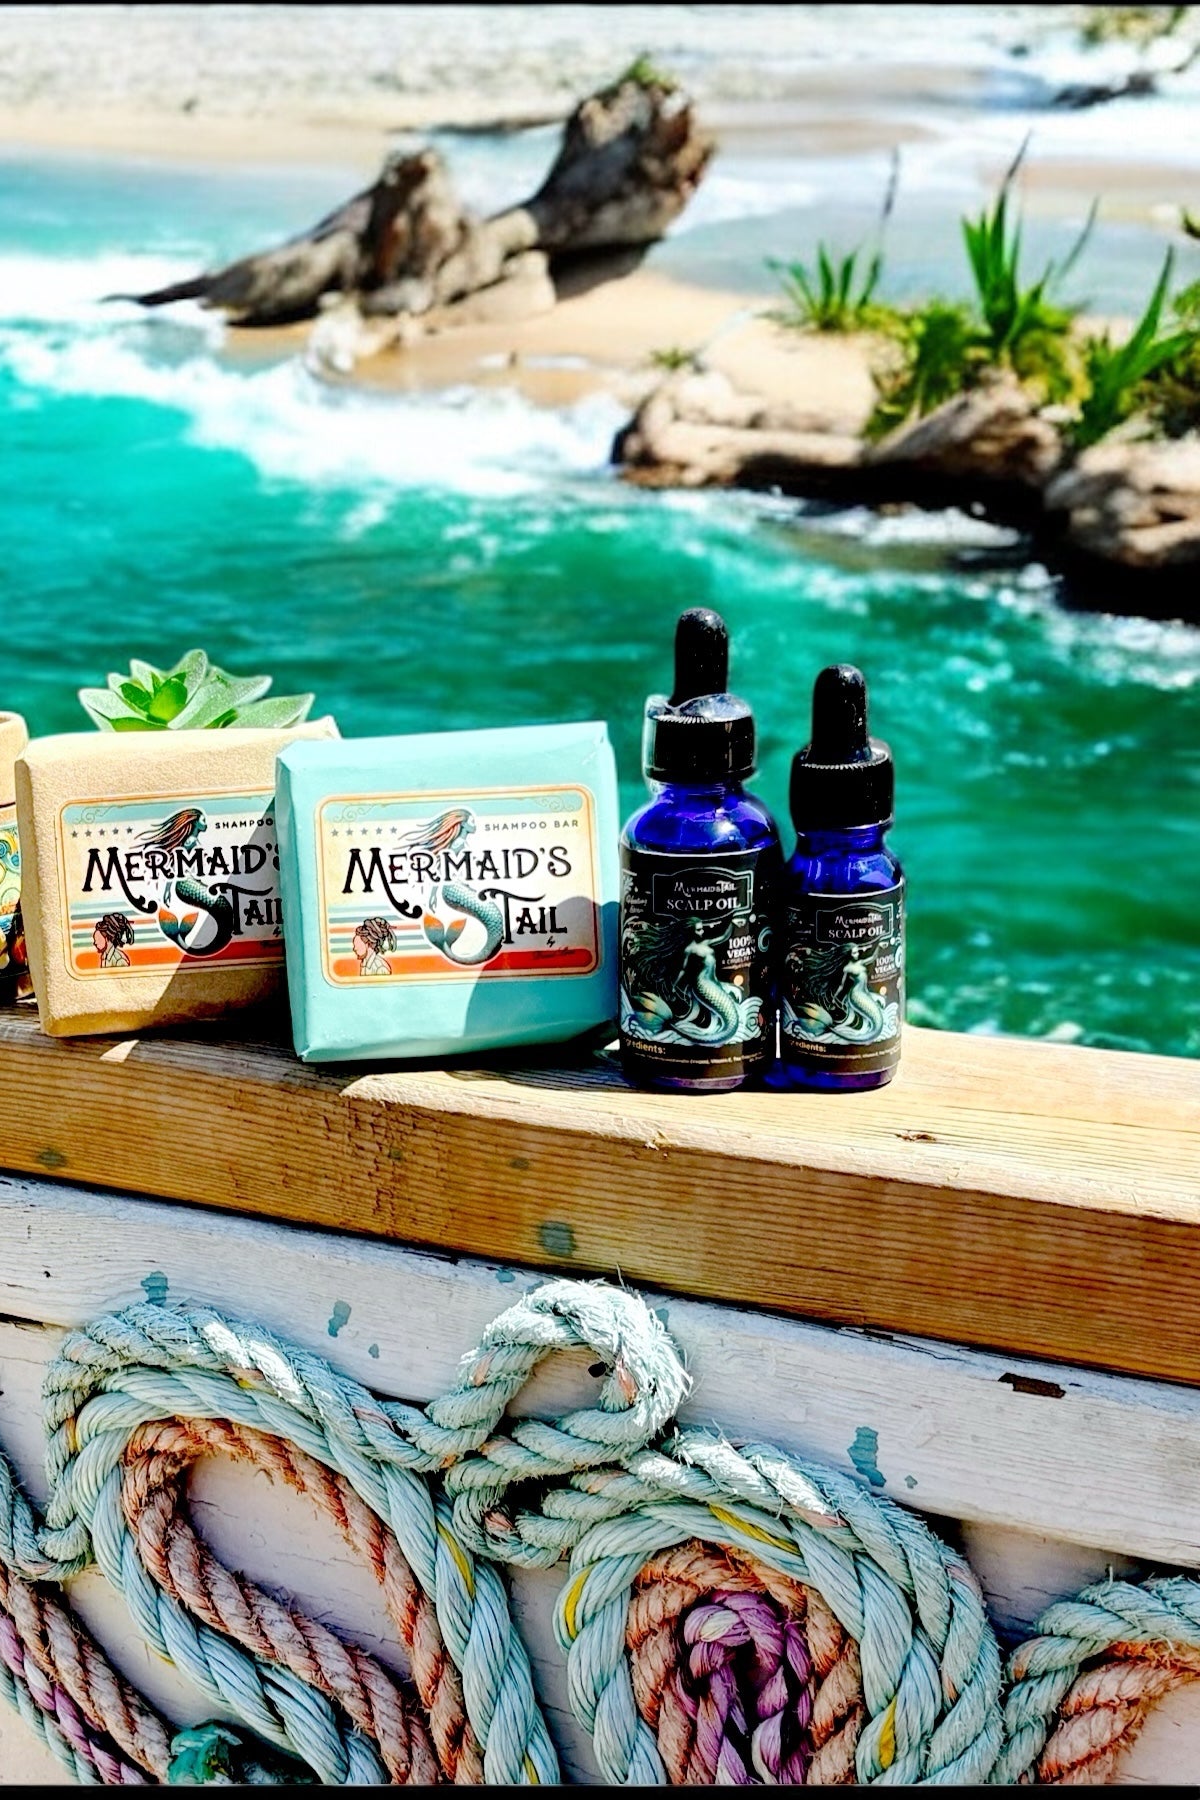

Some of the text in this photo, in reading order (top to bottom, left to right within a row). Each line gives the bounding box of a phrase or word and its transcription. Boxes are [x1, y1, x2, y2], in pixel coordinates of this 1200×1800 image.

[215, 818, 274, 830] SHAMPOO
[484, 819, 579, 832] SHAMPOO BAR
[342, 846, 572, 919] MERMAID'S
[666, 897, 741, 910] SCALP OIL
[478, 888, 567, 944] TAIL
[828, 925, 886, 939] SCALP OIL
[728, 935, 756, 949] 100%
[726, 946, 756, 959] VEGAN
